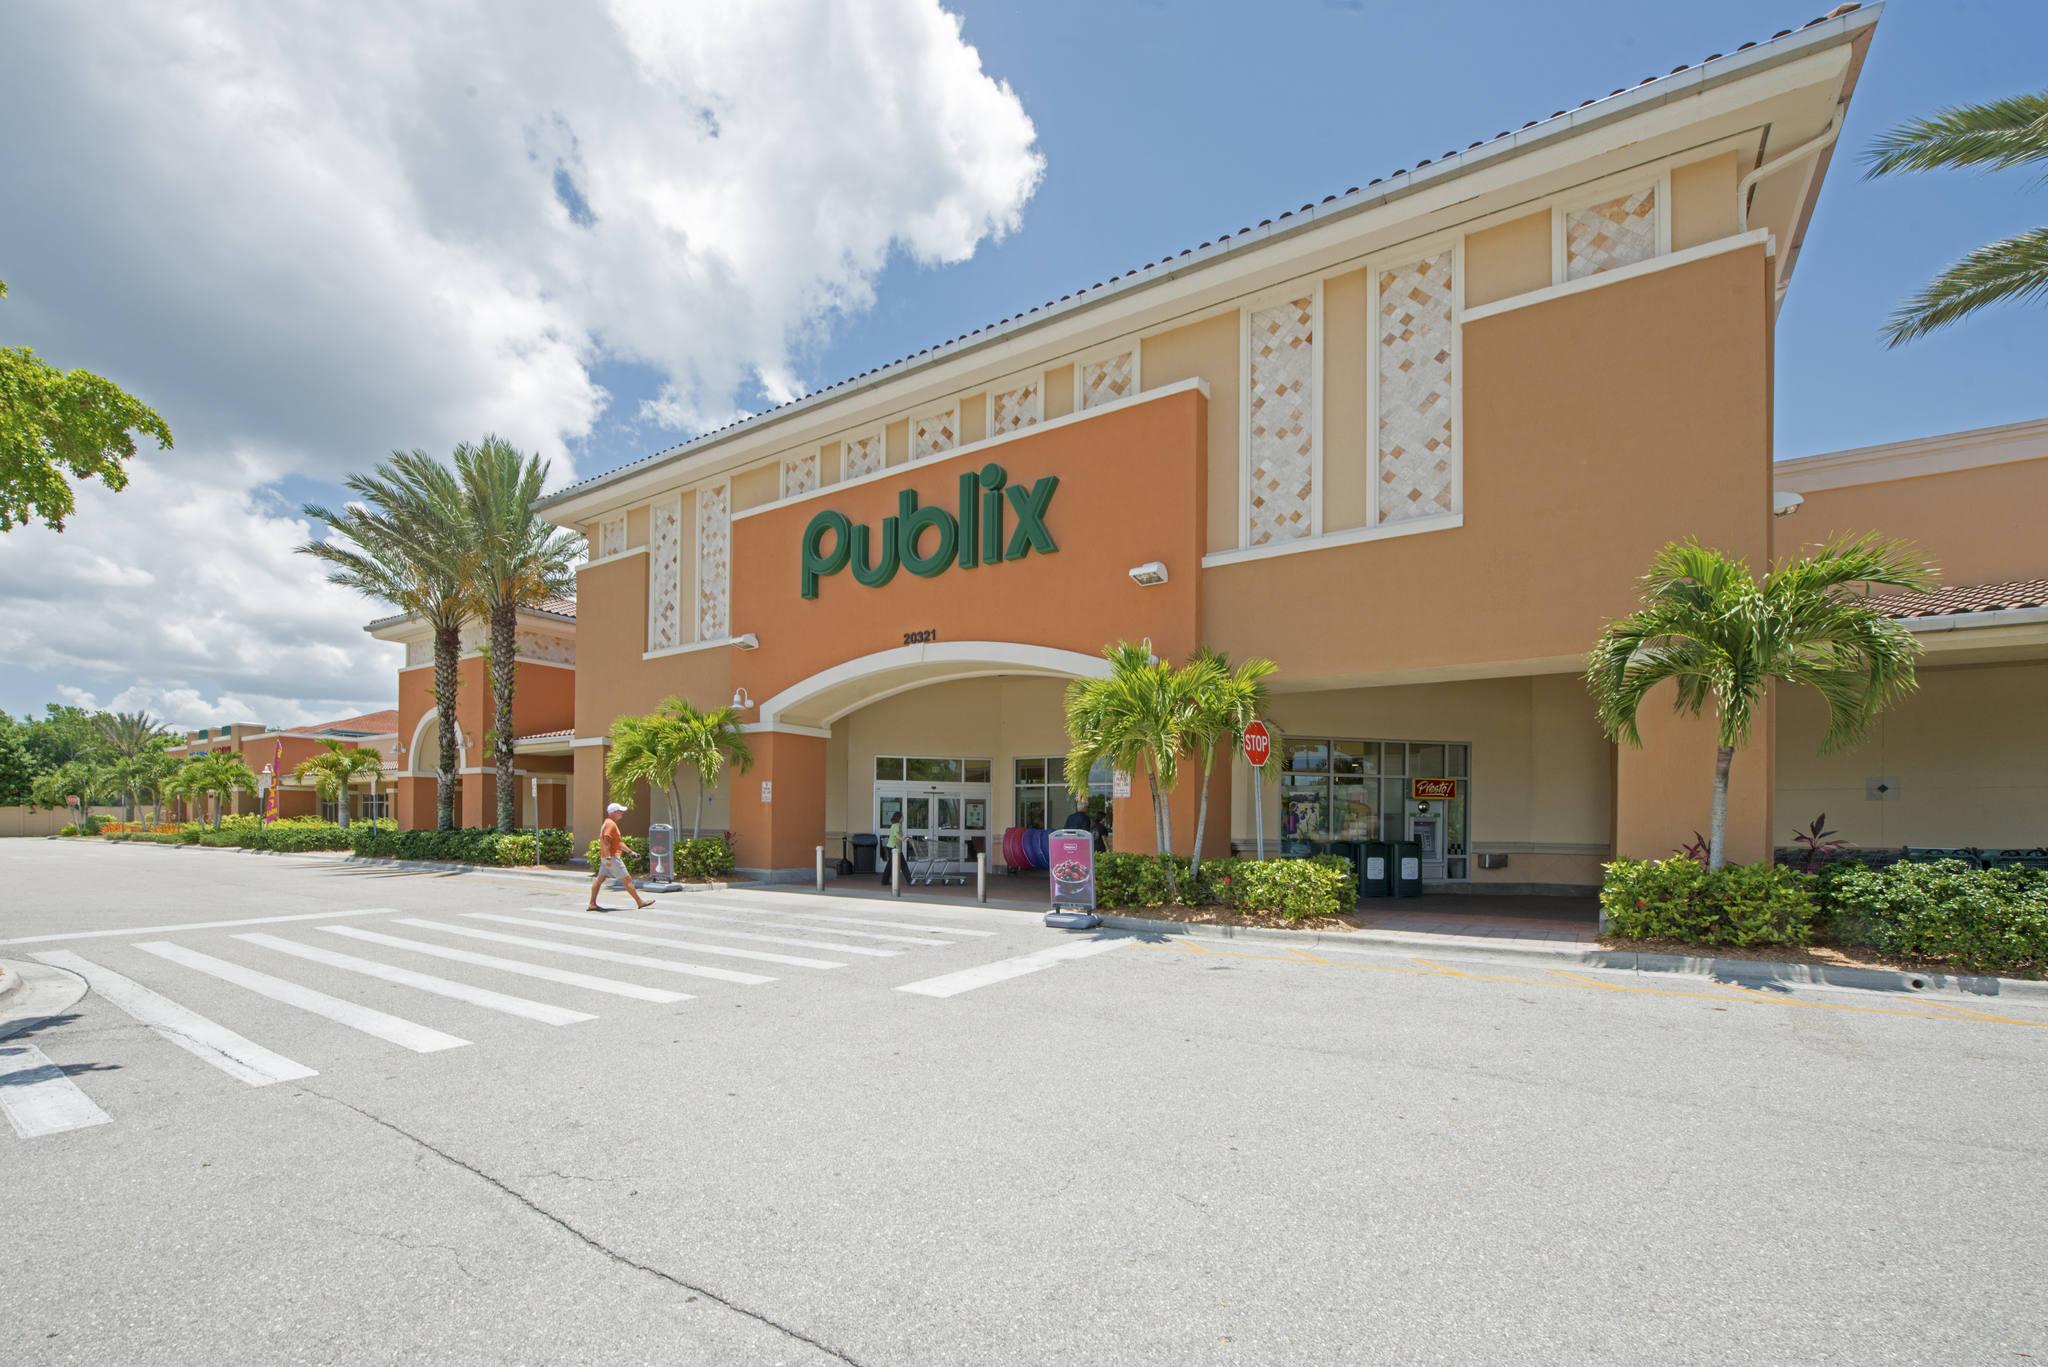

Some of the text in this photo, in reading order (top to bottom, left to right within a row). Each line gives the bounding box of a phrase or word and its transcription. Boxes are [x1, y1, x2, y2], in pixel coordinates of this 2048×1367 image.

[801, 463, 1060, 600] publix
[904, 628, 936, 645] 20321
[1245, 734, 1268, 752] STOP
[1416, 781, 1454, 797] Presto!
